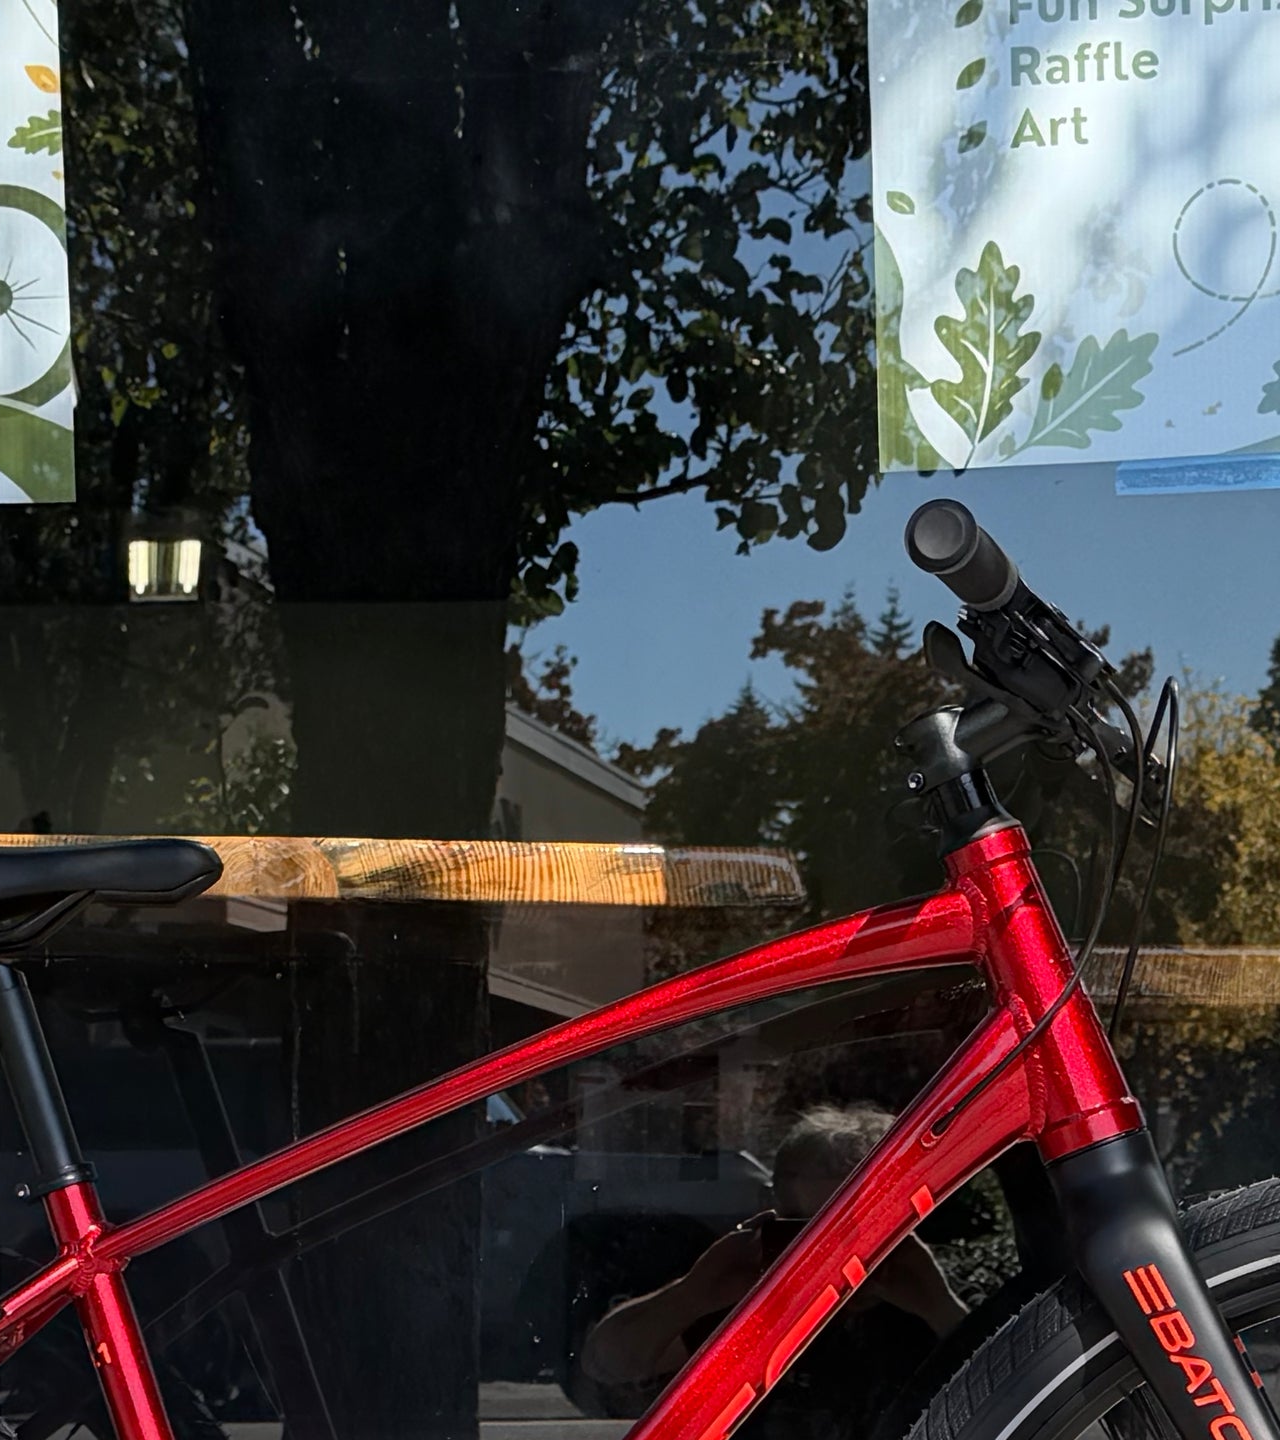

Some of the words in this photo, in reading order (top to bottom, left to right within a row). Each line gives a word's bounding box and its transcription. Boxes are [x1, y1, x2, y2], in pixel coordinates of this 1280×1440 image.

[1008, 0, 1099, 26] Fun
[1009, 41, 1160, 88] Raffle
[1009, 107, 1089, 149] Art
